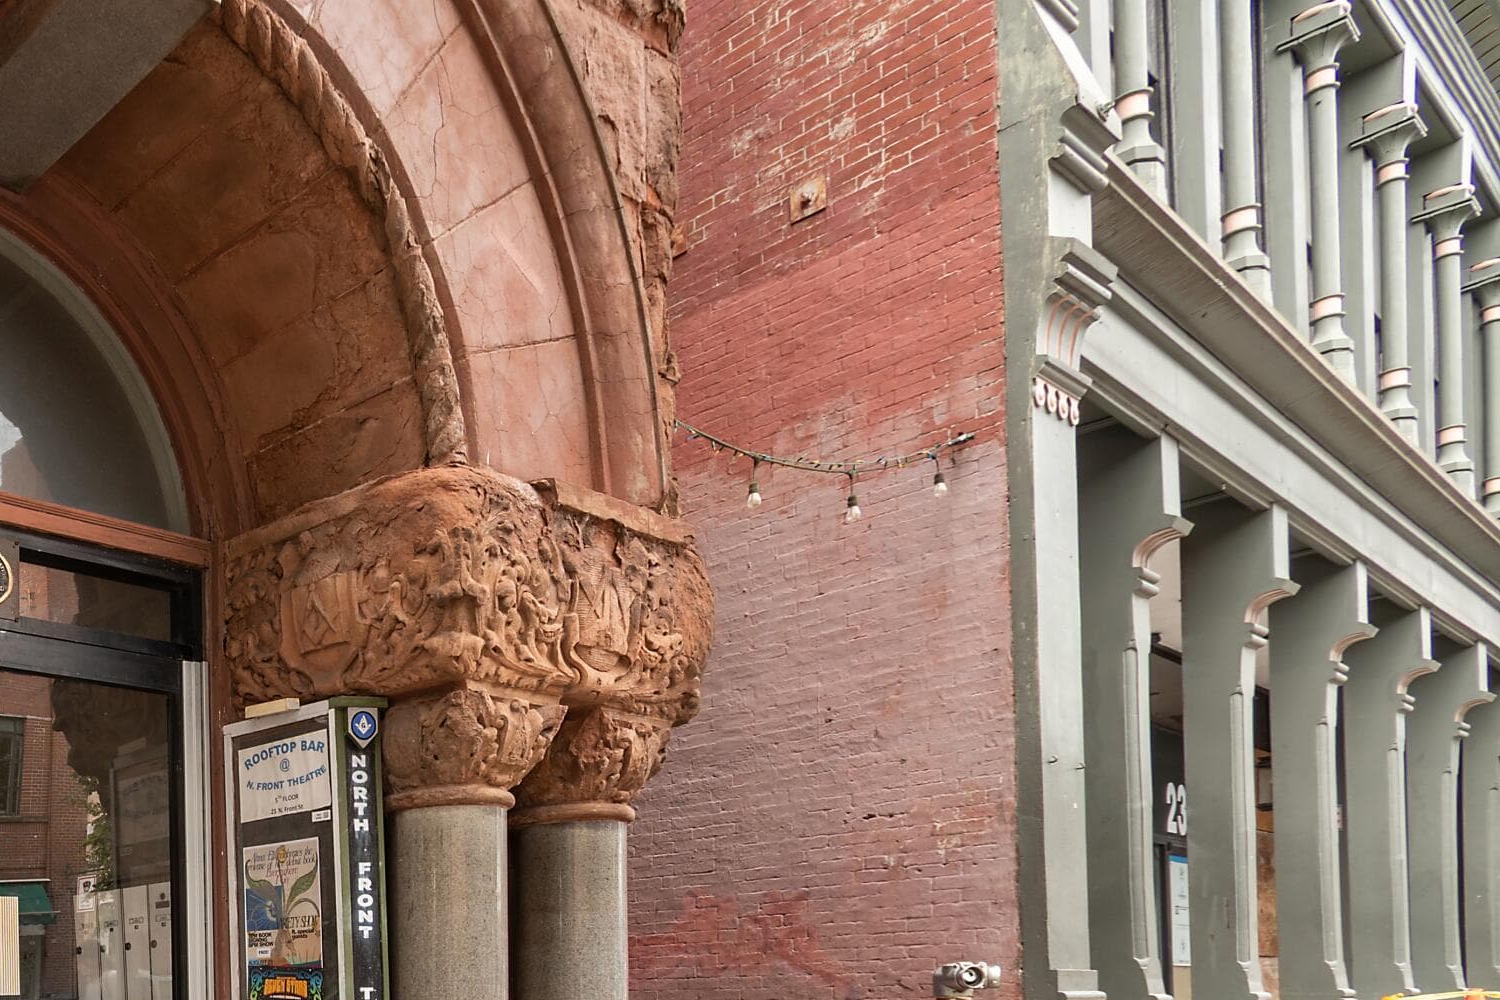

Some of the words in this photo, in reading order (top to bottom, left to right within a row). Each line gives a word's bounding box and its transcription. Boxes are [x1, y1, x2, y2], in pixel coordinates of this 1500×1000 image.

[244, 742, 297, 770] ROOFTOP
[300, 740, 325, 753] BAR
[279, 758, 290, 772] @
[246, 780, 254, 790] N.
[256, 781, 285, 791] FRONT
[287, 765, 327, 787] THEATRE
[351, 754, 369, 832] NORTH
[282, 793, 299, 802] FLOOR
[1165, 782, 1187, 836] 23
[357, 862, 374, 939] FRONT
